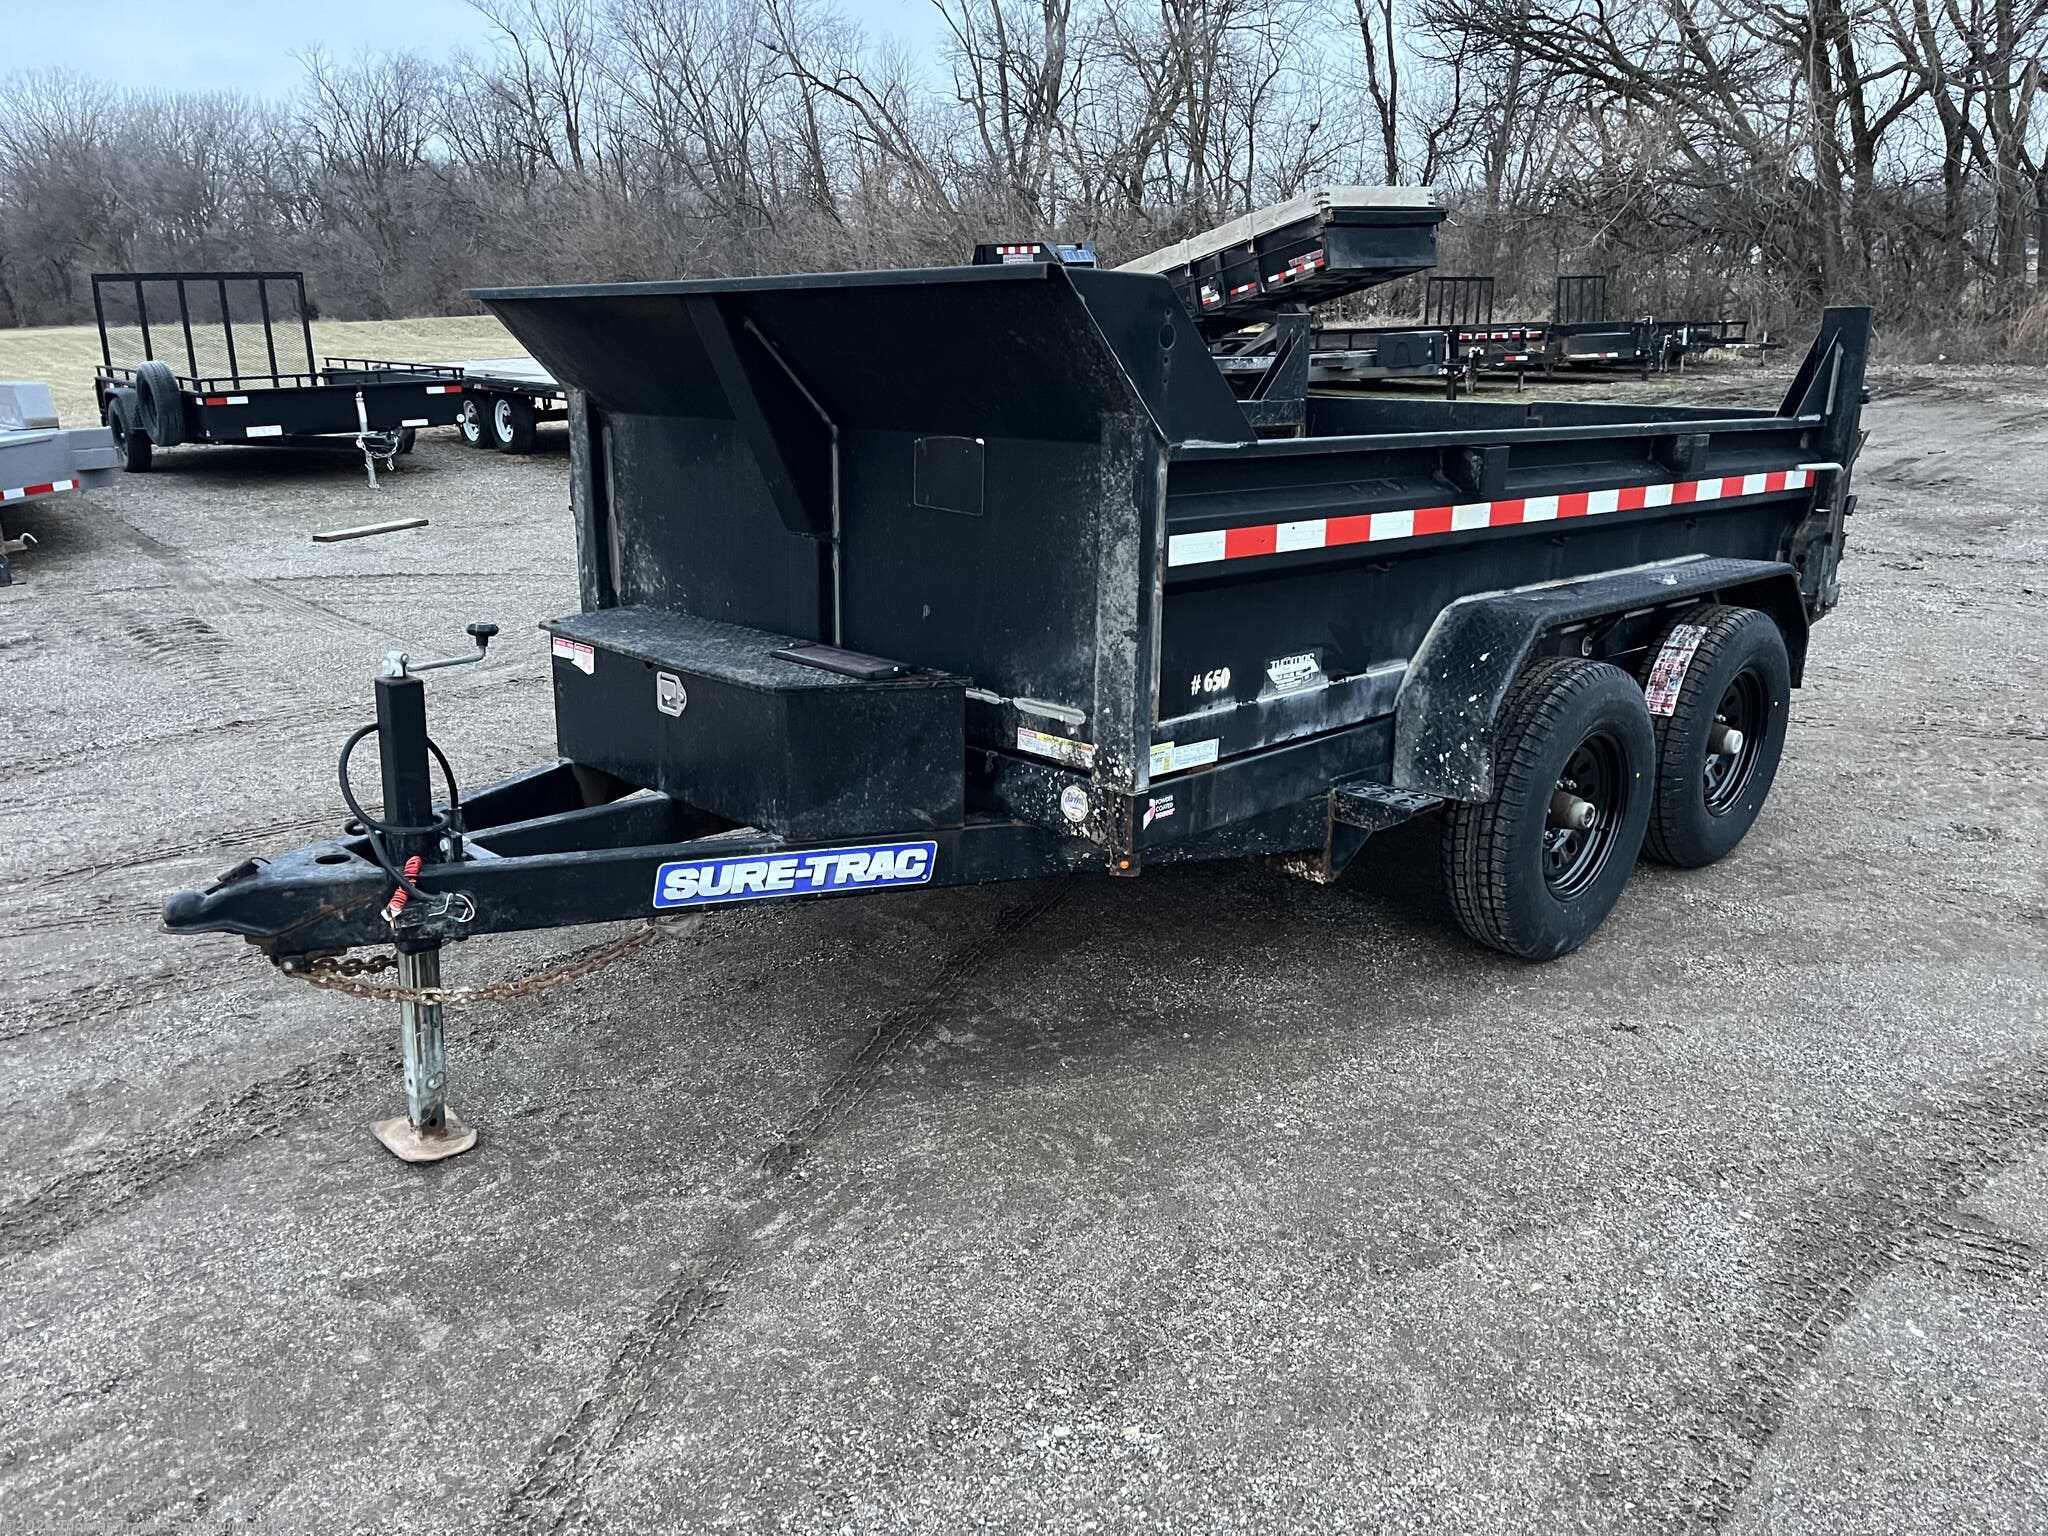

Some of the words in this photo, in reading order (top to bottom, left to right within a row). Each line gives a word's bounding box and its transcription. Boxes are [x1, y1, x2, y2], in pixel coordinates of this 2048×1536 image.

[1190, 673, 1202, 696] #
[1203, 666, 1231, 692] 650
[663, 848, 929, 901] SURE-TRAC
